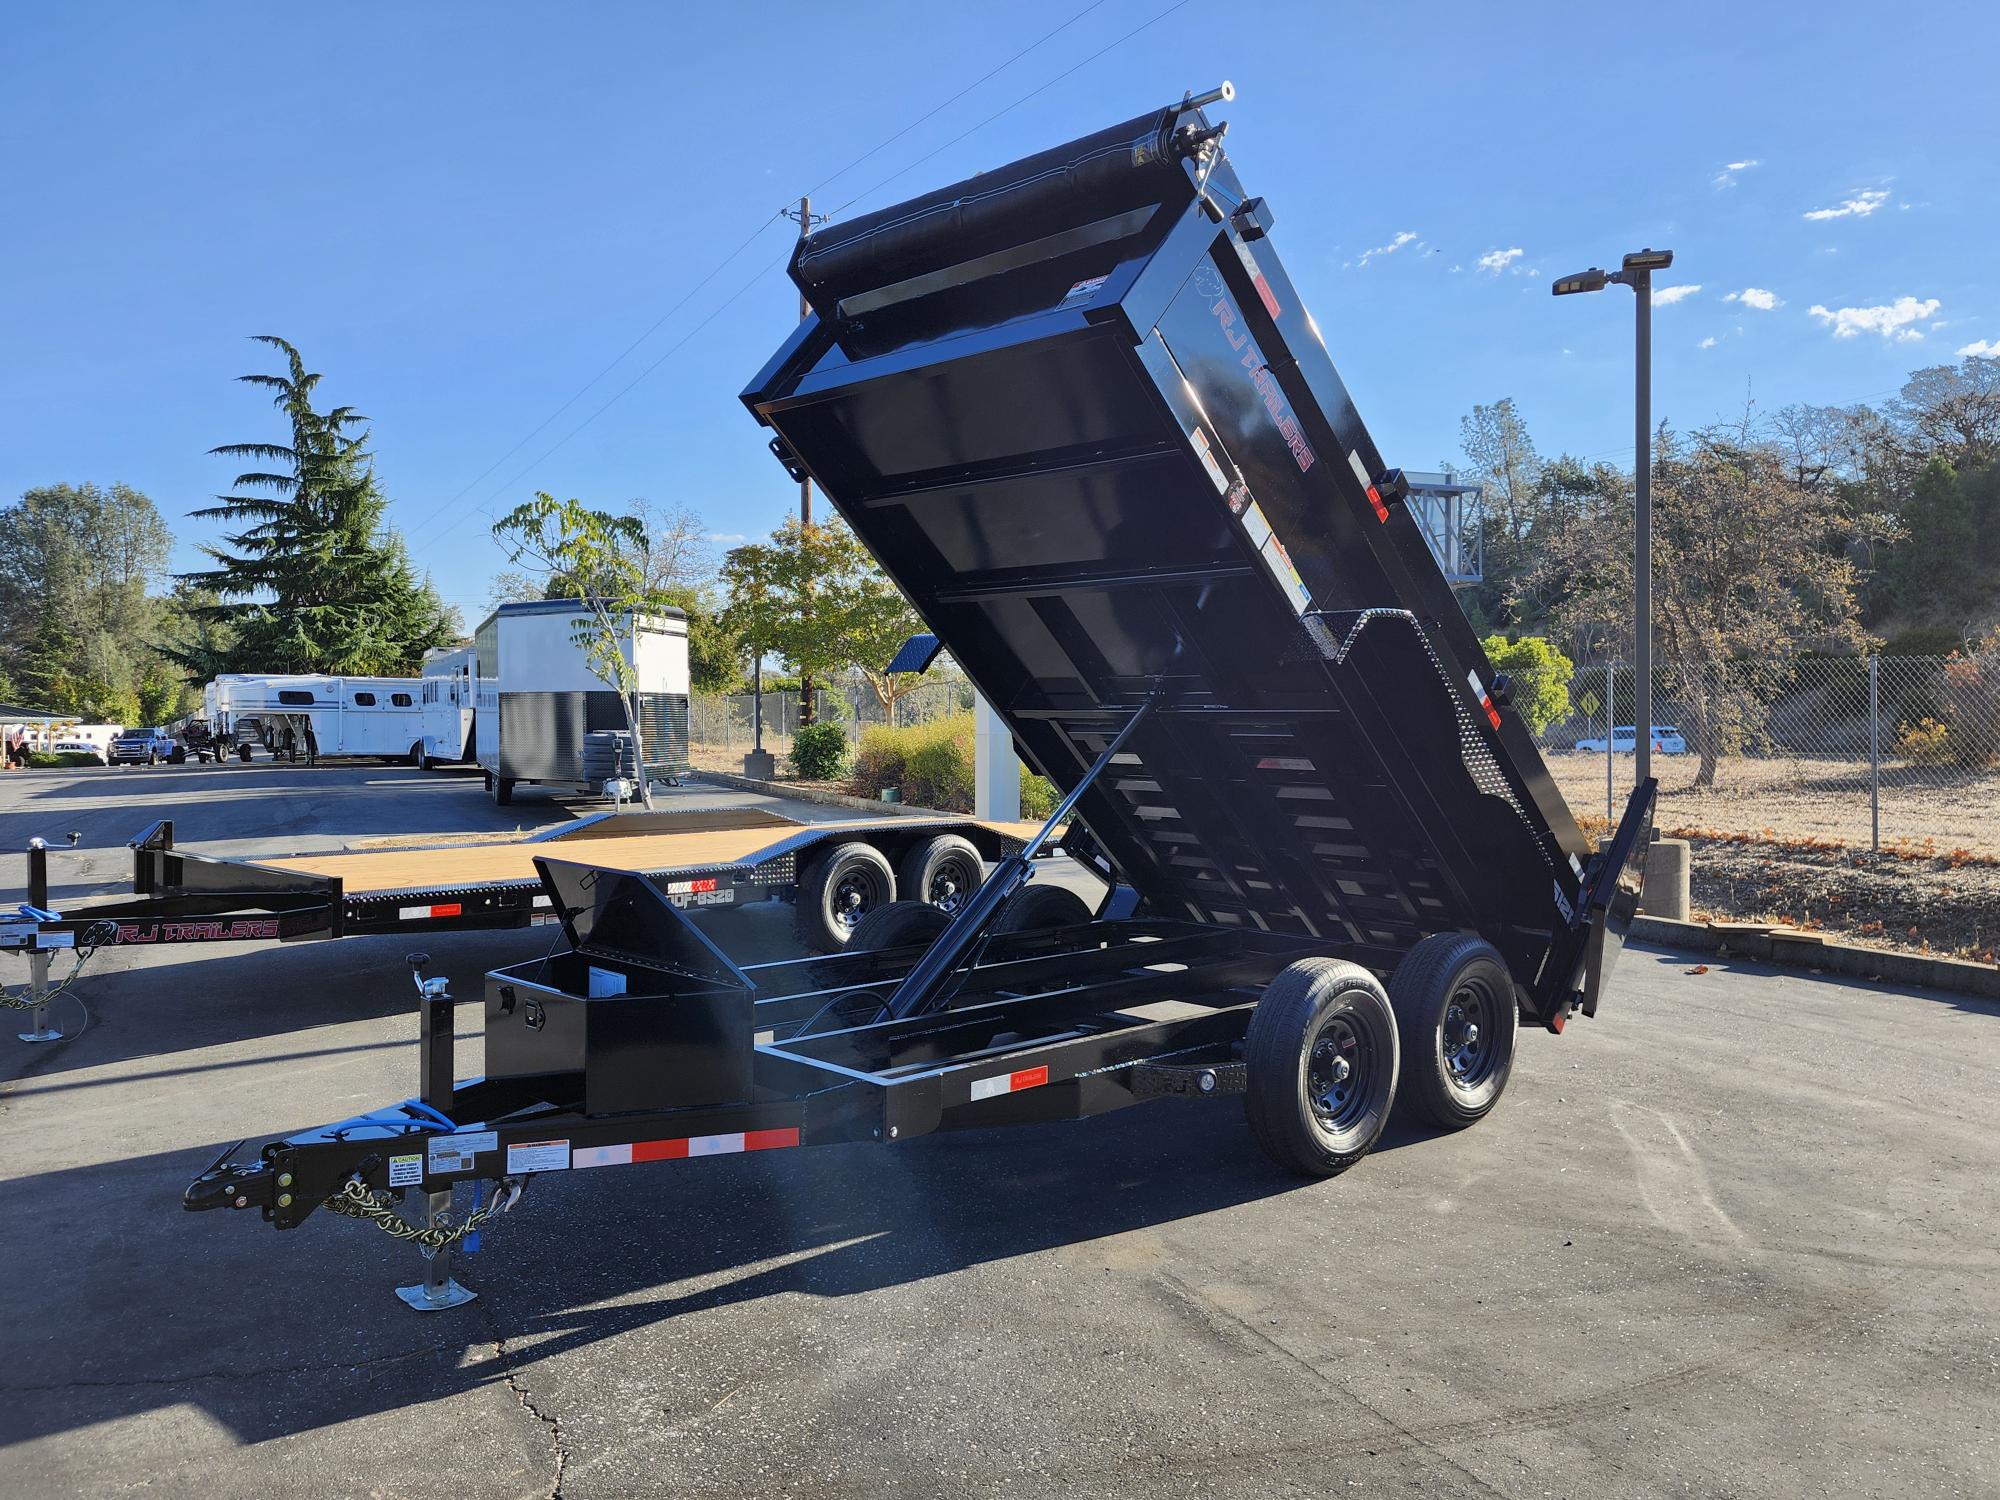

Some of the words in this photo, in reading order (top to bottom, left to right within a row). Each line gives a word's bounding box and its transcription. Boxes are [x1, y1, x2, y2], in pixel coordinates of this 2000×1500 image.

[1213, 297, 1248, 351] RJ
[1241, 344, 1315, 473] TRAILERS
[116, 925, 159, 942] RJ
[162, 920, 279, 940] TRAILERS
